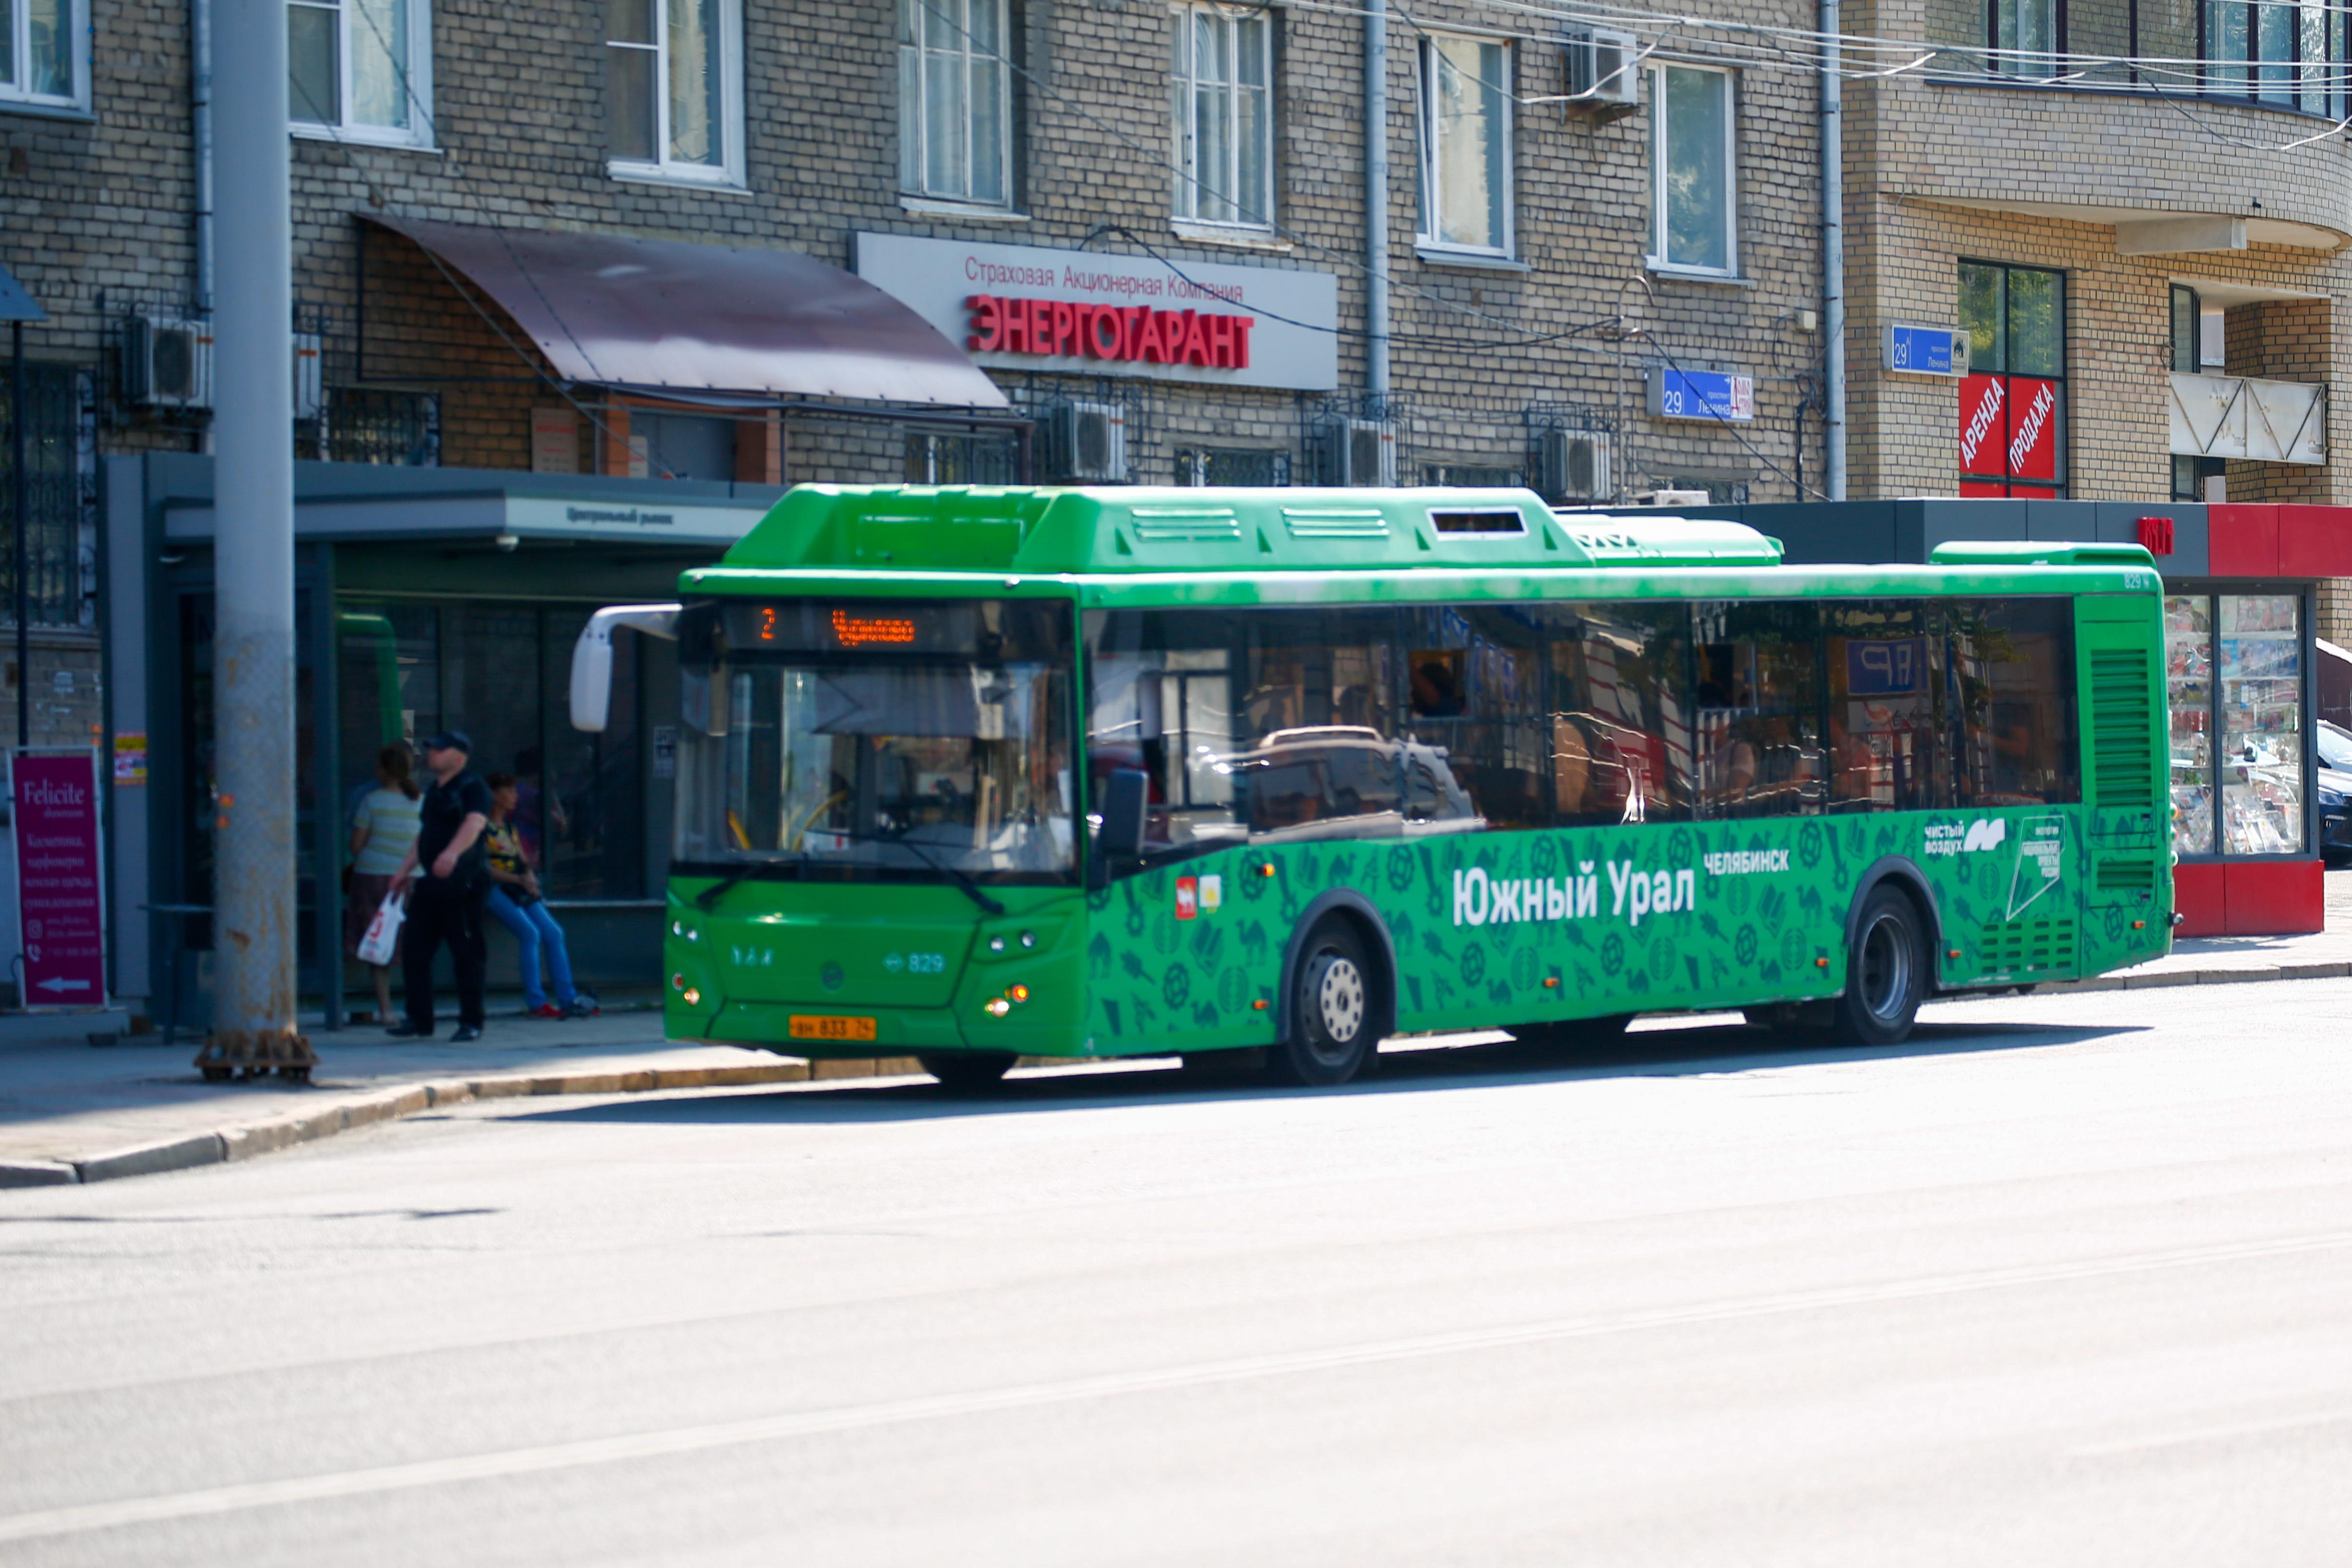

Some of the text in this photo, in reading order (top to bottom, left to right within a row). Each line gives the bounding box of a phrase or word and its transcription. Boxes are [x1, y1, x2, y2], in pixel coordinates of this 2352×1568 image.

[965, 256, 1243, 303] Страховая Акционерная Компания
[967, 293, 1254, 369] ЭНЕРГОГАРАНТ
[1894, 343, 1907, 365] 29
[1927, 356, 1949, 369] Ленина
[1664, 390, 1682, 414] 29
[1698, 399, 1730, 415] Ленина
[1959, 377, 2004, 468] АРЕНДА
[2008, 383, 2054, 474] ПРОДАЖА
[2124, 574, 2141, 589] 829
[761, 607, 776, 639] 2
[1703, 849, 1789, 876] ЧЕЛЯБИНСК
[1453, 859, 1694, 926] Южный Урал
[908, 952, 945, 973] 829
[819, 1019, 847, 1036] 833
